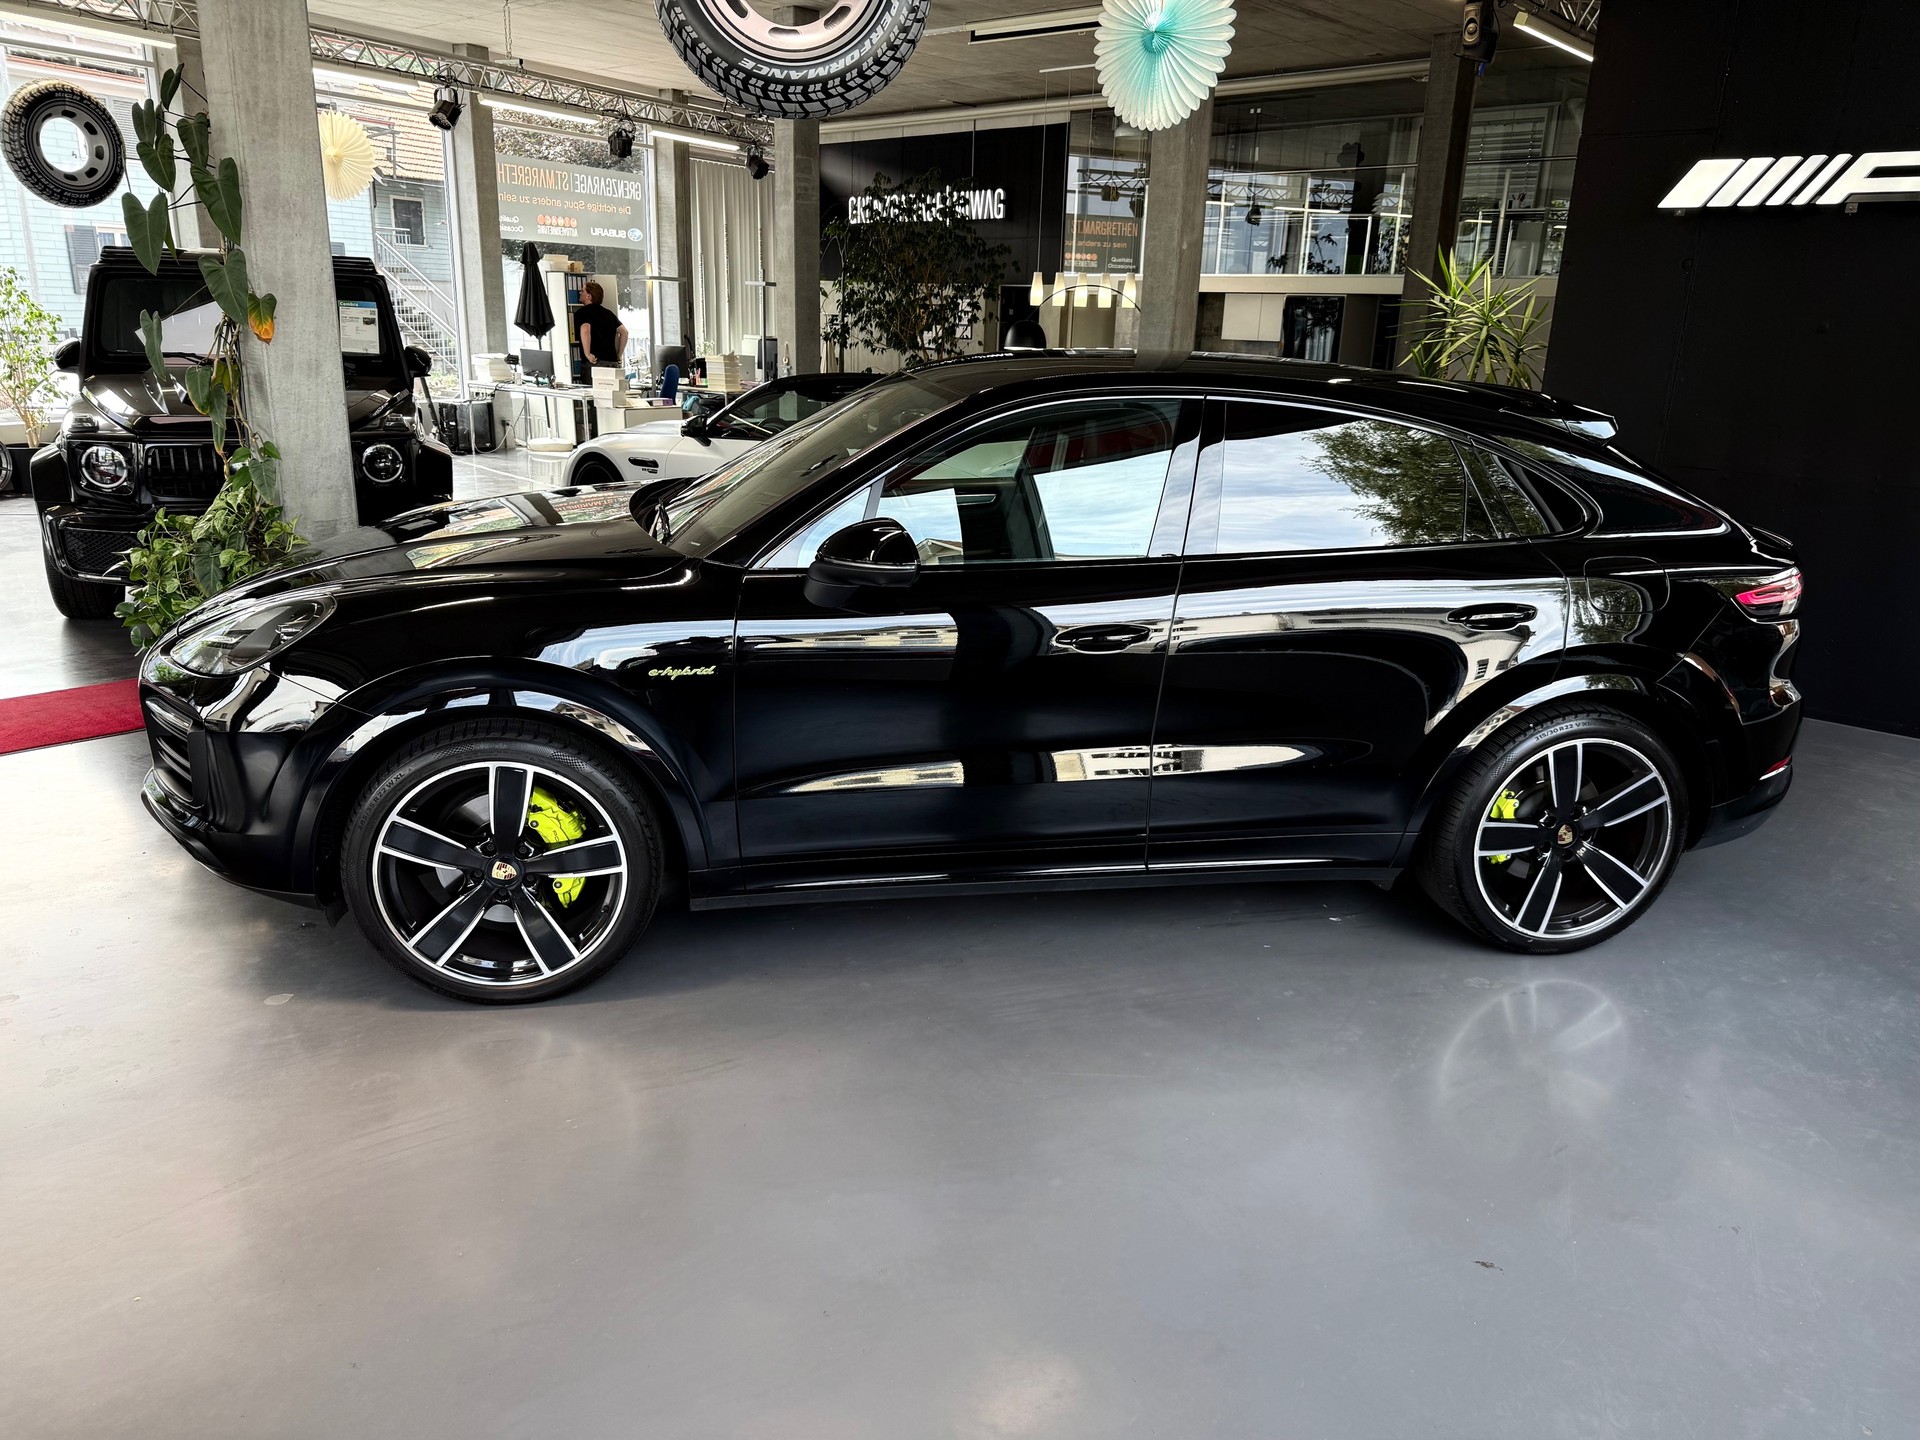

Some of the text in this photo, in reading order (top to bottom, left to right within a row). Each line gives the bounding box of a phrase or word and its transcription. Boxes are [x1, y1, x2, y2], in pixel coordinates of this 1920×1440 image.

[738, 0, 899, 79] PERFORMANCE
[648, 665, 717, 681] e-hybrid
[1534, 728, 1559, 742] 315/30
